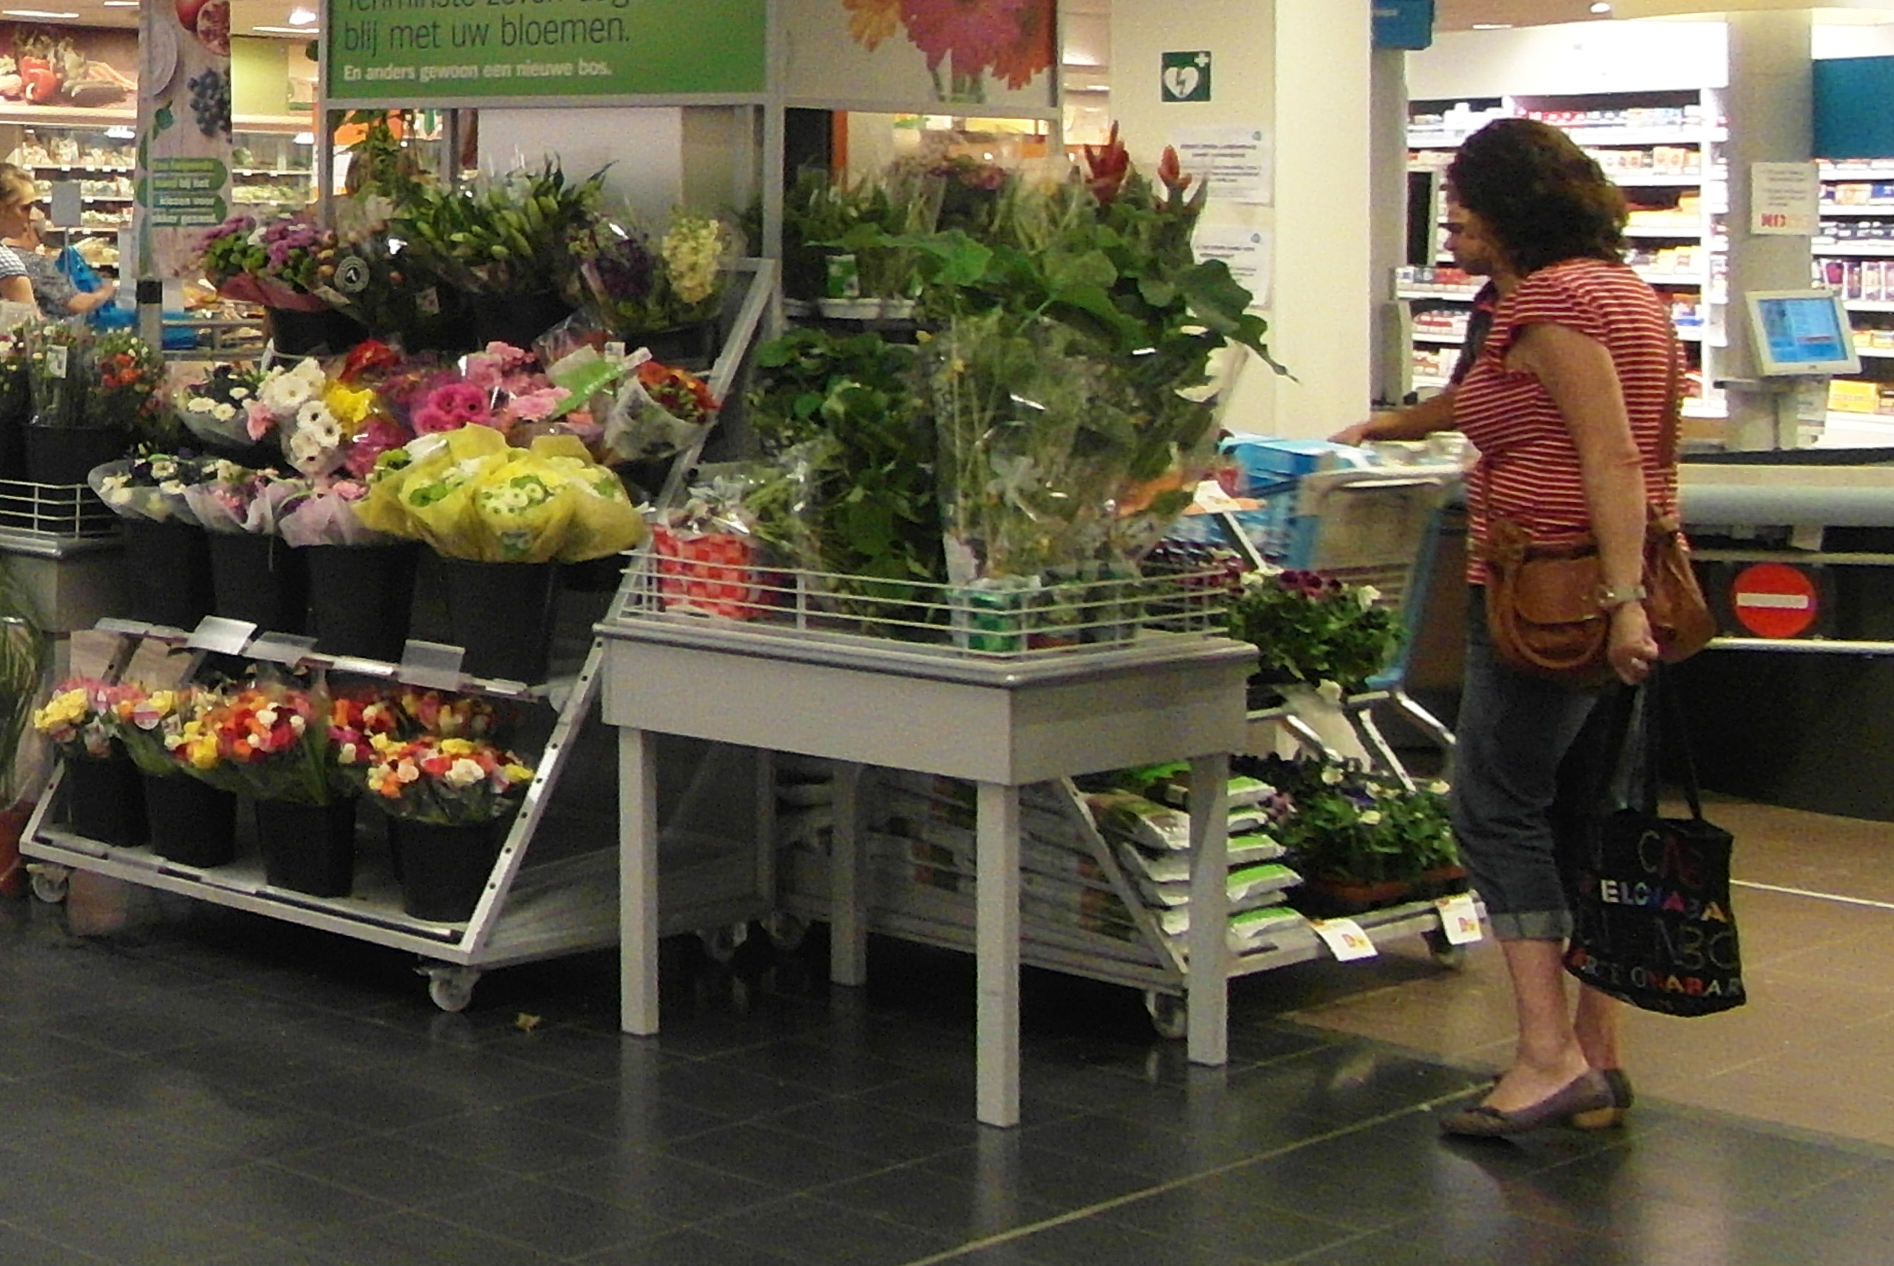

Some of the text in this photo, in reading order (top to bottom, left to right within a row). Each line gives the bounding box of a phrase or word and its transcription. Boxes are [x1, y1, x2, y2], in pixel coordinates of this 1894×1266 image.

[345, 13, 631, 56] blij met uw bloemen.
[344, 58, 613, 82] En anders gewoon een nieuwe bos.
